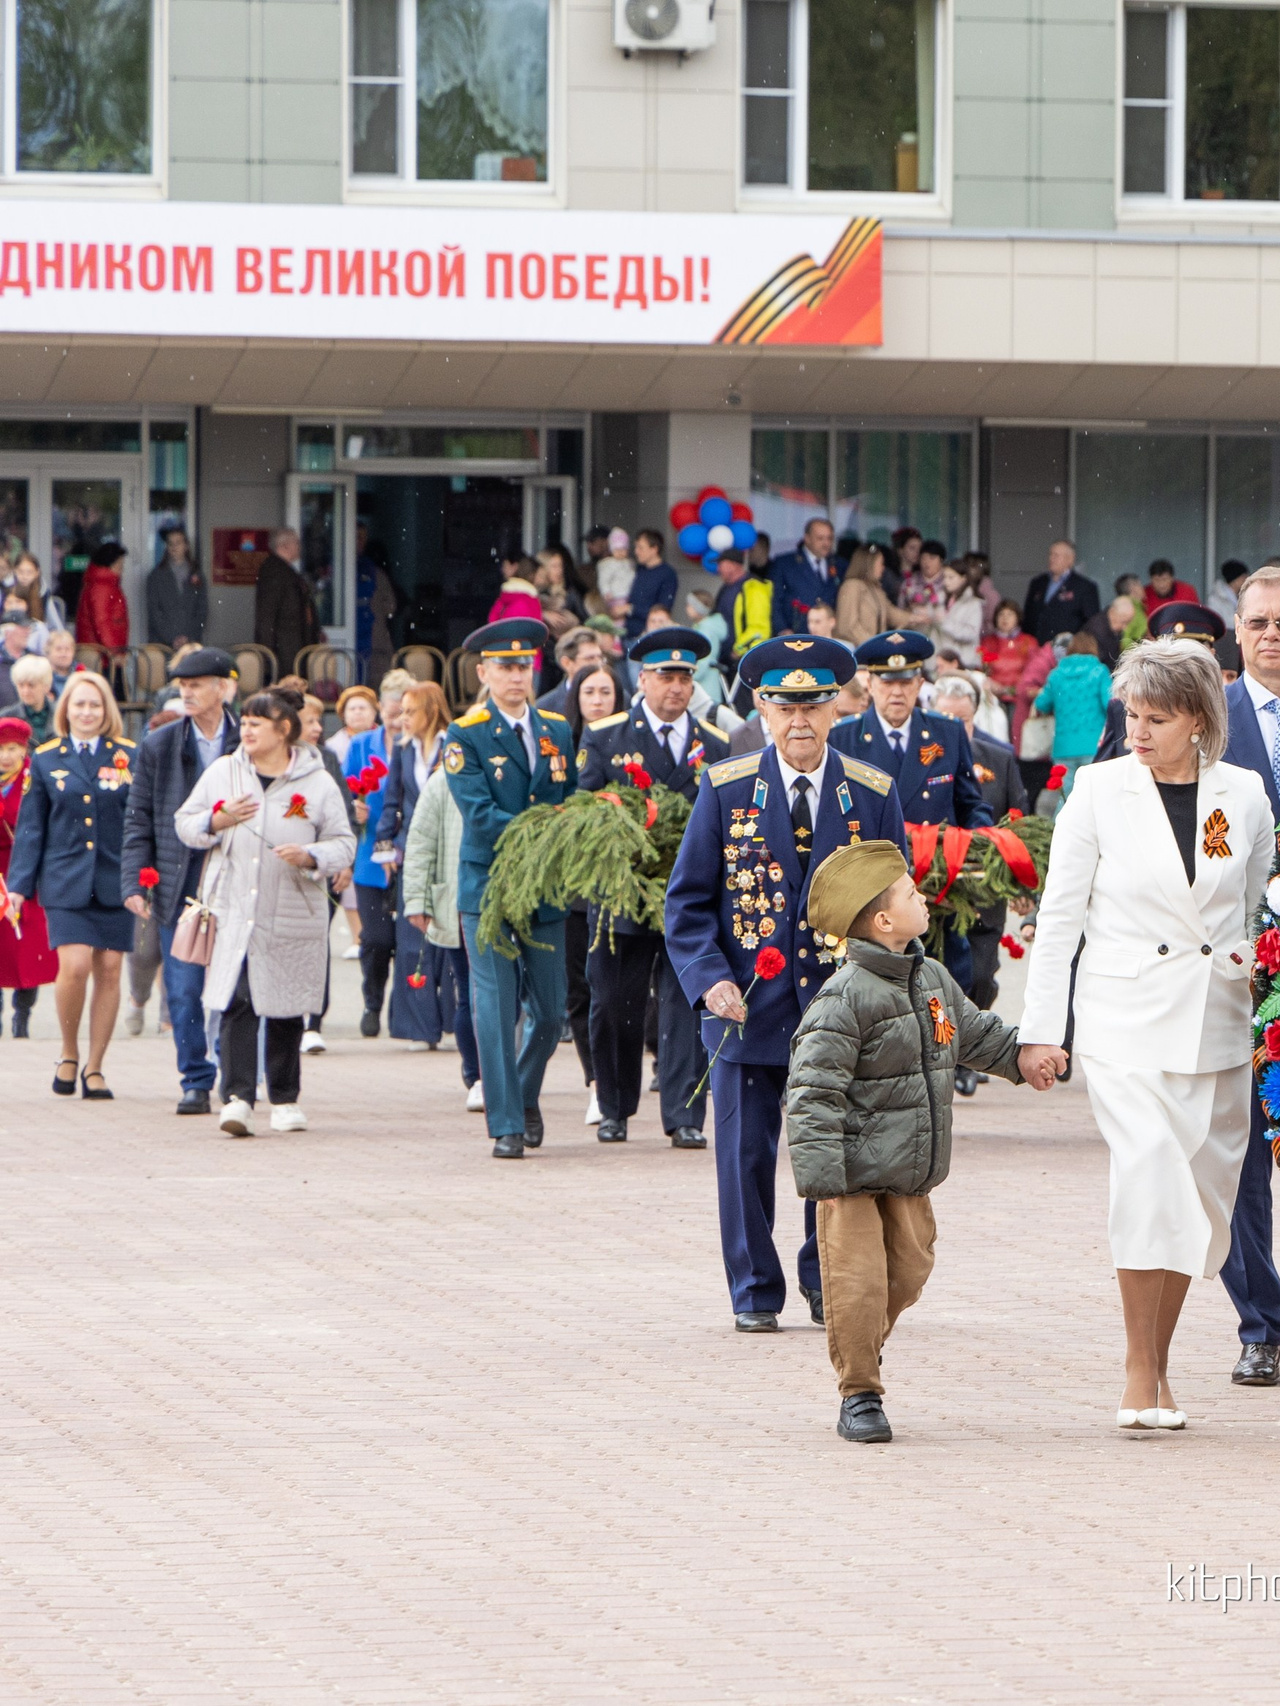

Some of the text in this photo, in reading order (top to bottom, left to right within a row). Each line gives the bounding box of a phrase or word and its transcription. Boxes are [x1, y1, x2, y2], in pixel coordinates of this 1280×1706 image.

[0, 241, 710, 310] ДНИКОМ ВЕЛИКОЙ ПОБЕДЫ!
